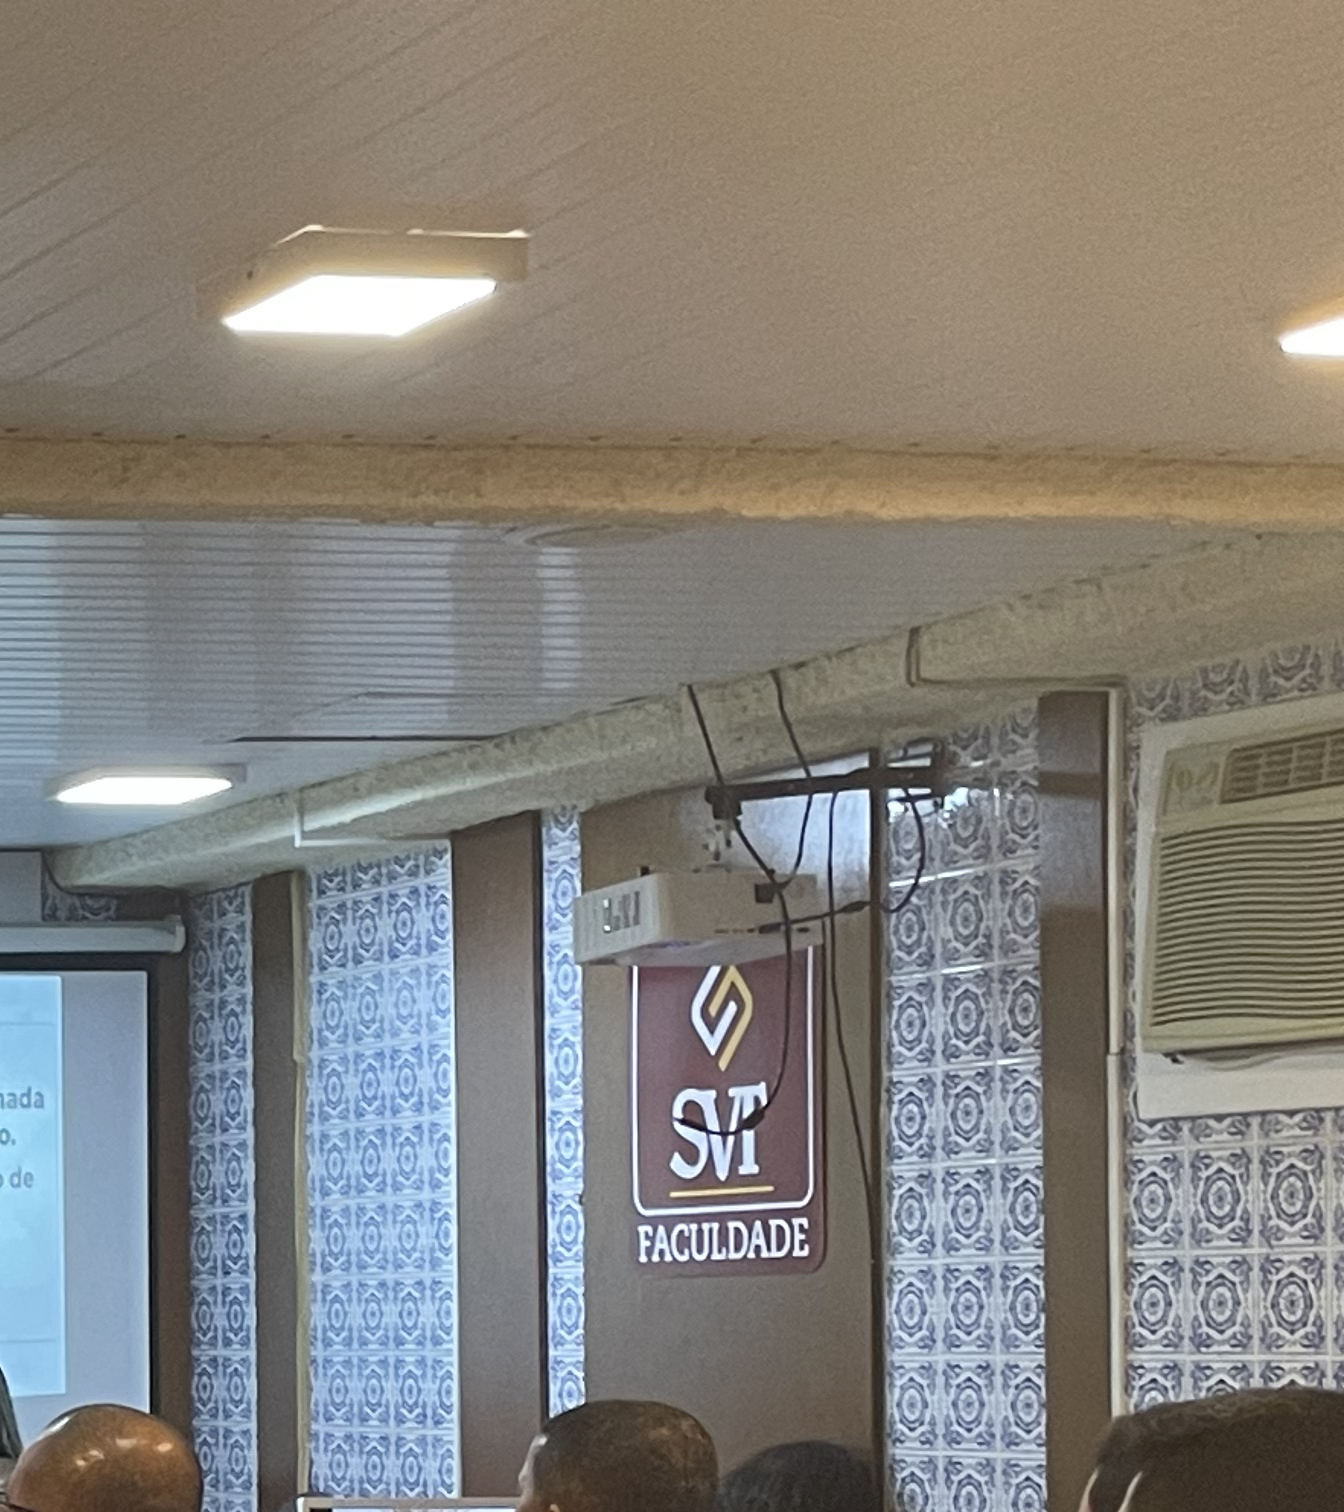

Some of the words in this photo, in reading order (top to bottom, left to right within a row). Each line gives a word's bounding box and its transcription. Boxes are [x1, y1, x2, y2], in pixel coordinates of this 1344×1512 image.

[668, 1081, 768, 1182] SVT
[9, 1166, 35, 1189] de
[637, 1217, 810, 1263] FACULDADE
